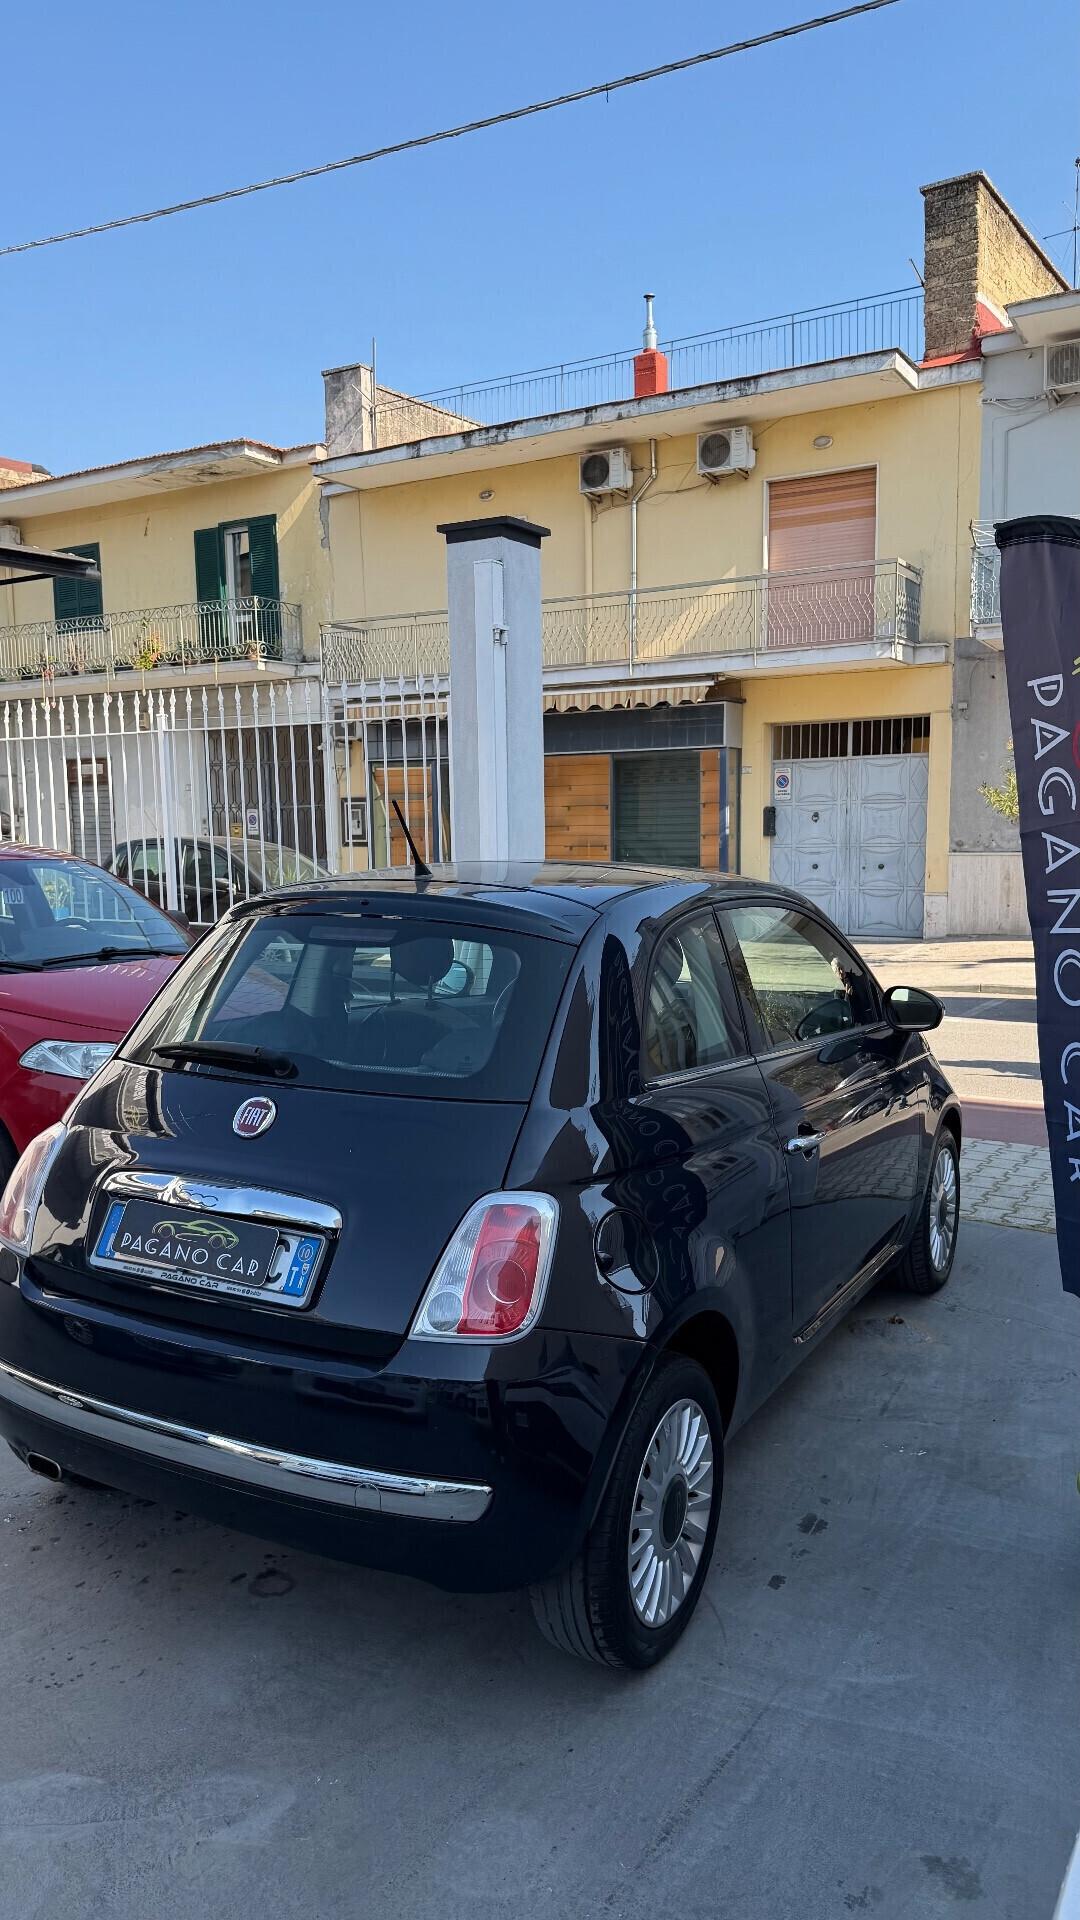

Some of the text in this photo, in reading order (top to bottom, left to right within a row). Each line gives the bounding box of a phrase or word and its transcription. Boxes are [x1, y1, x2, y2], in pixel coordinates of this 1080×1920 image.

[1027, 674, 1080, 1007] PAGANO
[5, 888, 22, 903] 100
[240, 1106, 269, 1127] FIAT
[120, 1232, 259, 1277] PAGANO CAR
[160, 1271, 219, 1289] PAGANO CAR
